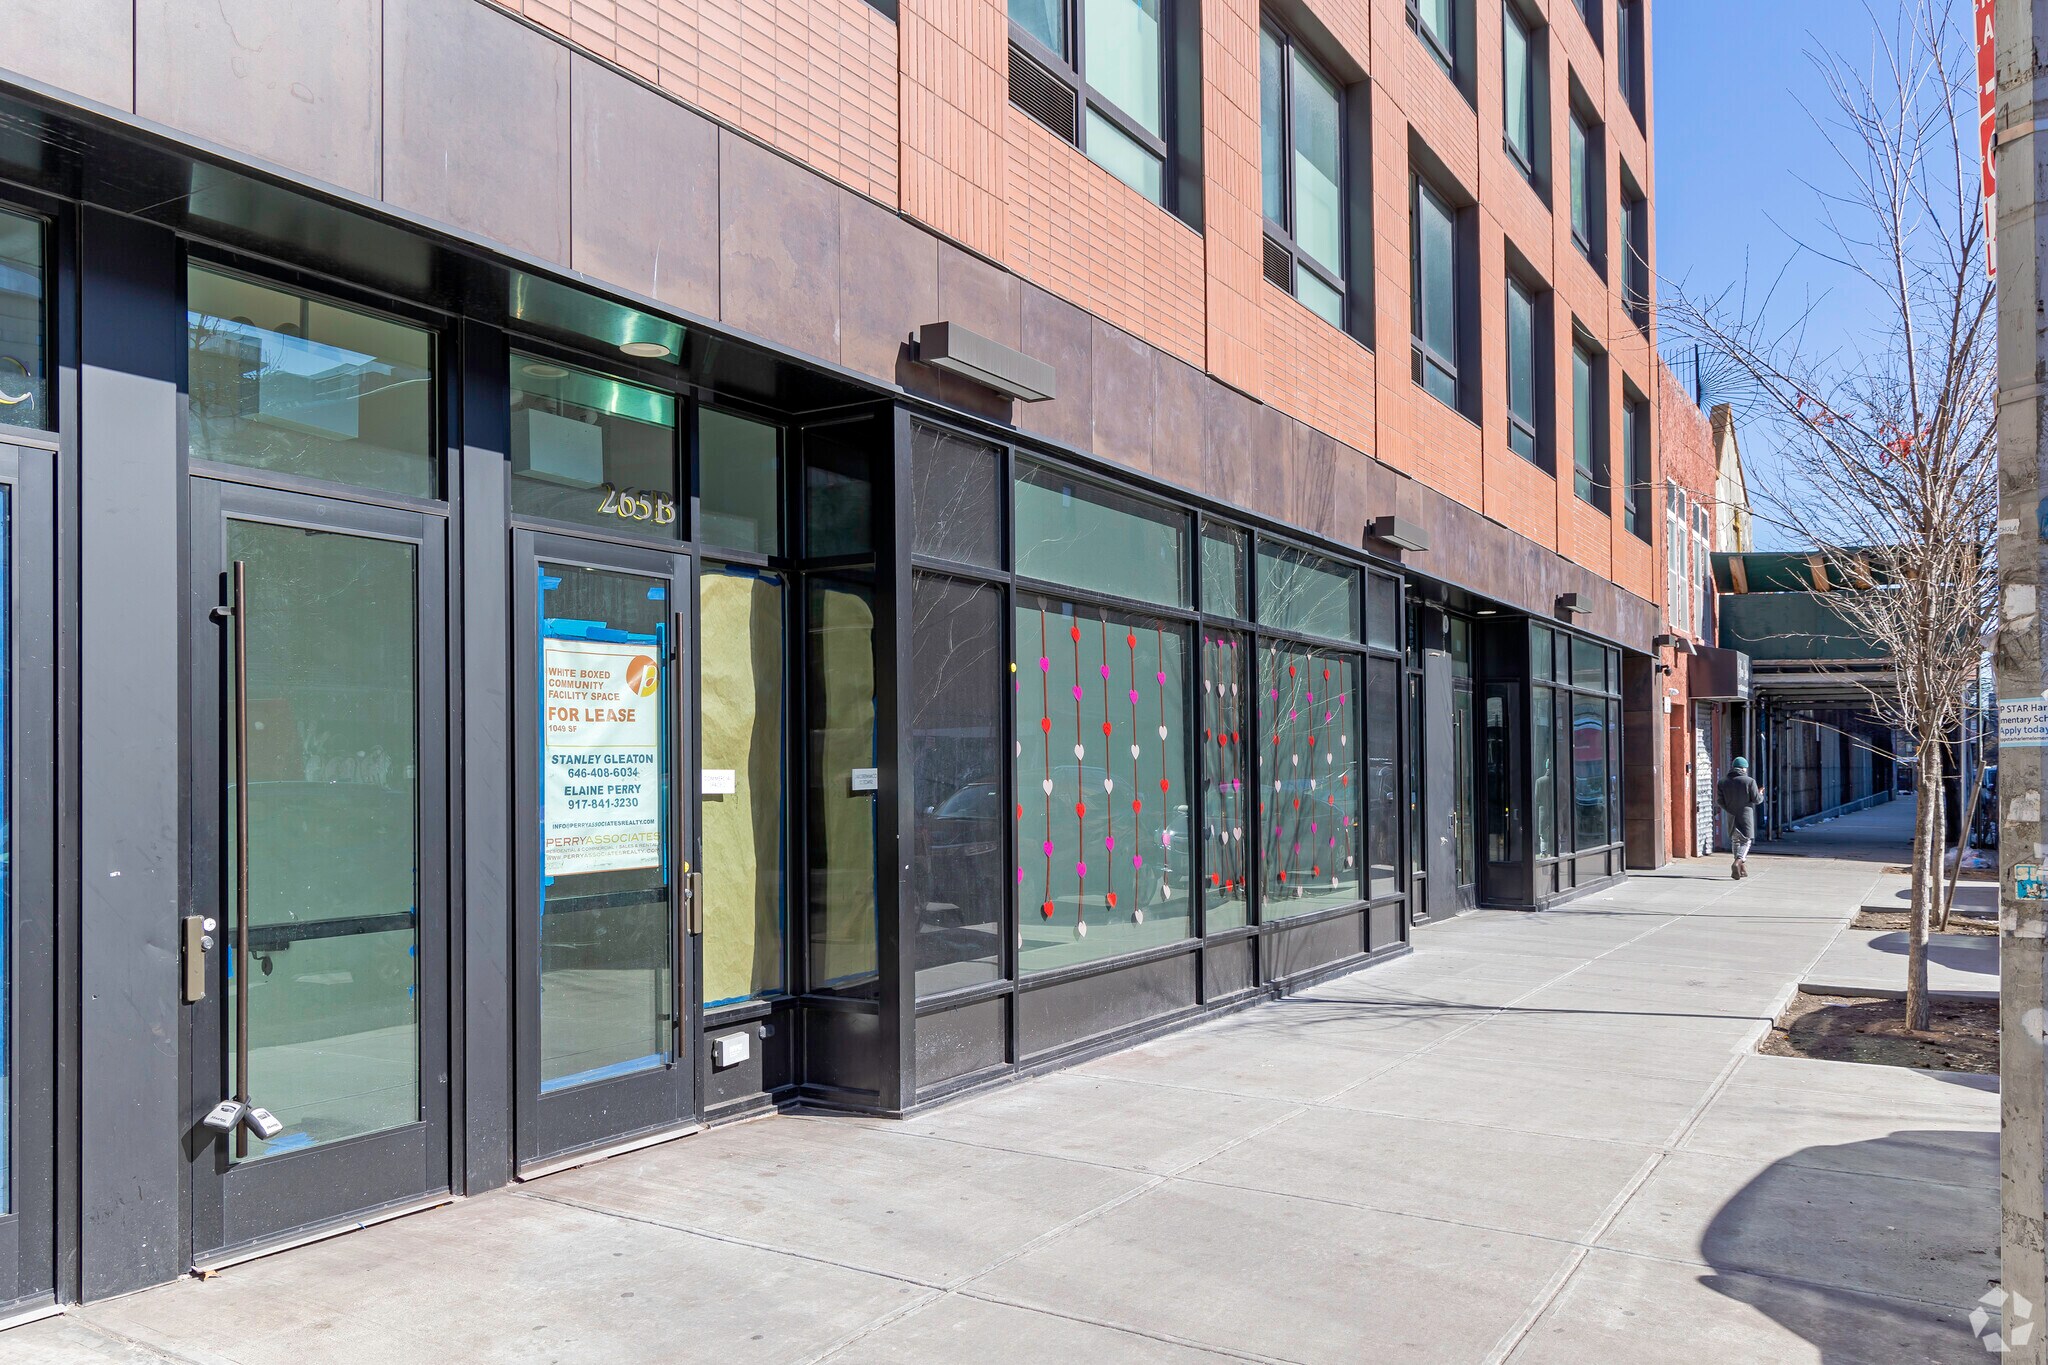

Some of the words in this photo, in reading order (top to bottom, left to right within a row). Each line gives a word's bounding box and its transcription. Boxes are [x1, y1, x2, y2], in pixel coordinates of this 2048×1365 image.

[597, 482, 676, 525] 265B
[548, 668, 576, 678] WHITE
[580, 670, 611, 679] BOXED
[548, 679, 604, 690] COMMUNITY
[548, 690, 588, 700] FACILITY
[590, 693, 620, 701] SPACE
[548, 707, 579, 721] FOR
[585, 708, 636, 722] LEASE
[2007, 705, 2029, 713] STAR
[551, 755, 602, 765] STANLEY
[604, 754, 654, 764] GLEATON
[567, 767, 638, 778] 646-408-6034
[564, 785, 604, 796] ELAINE
[607, 784, 641, 795] PERRY
[568, 797, 639, 809] 917-841-3230
[546, 832, 660, 847] PERRYASSOCIATES
